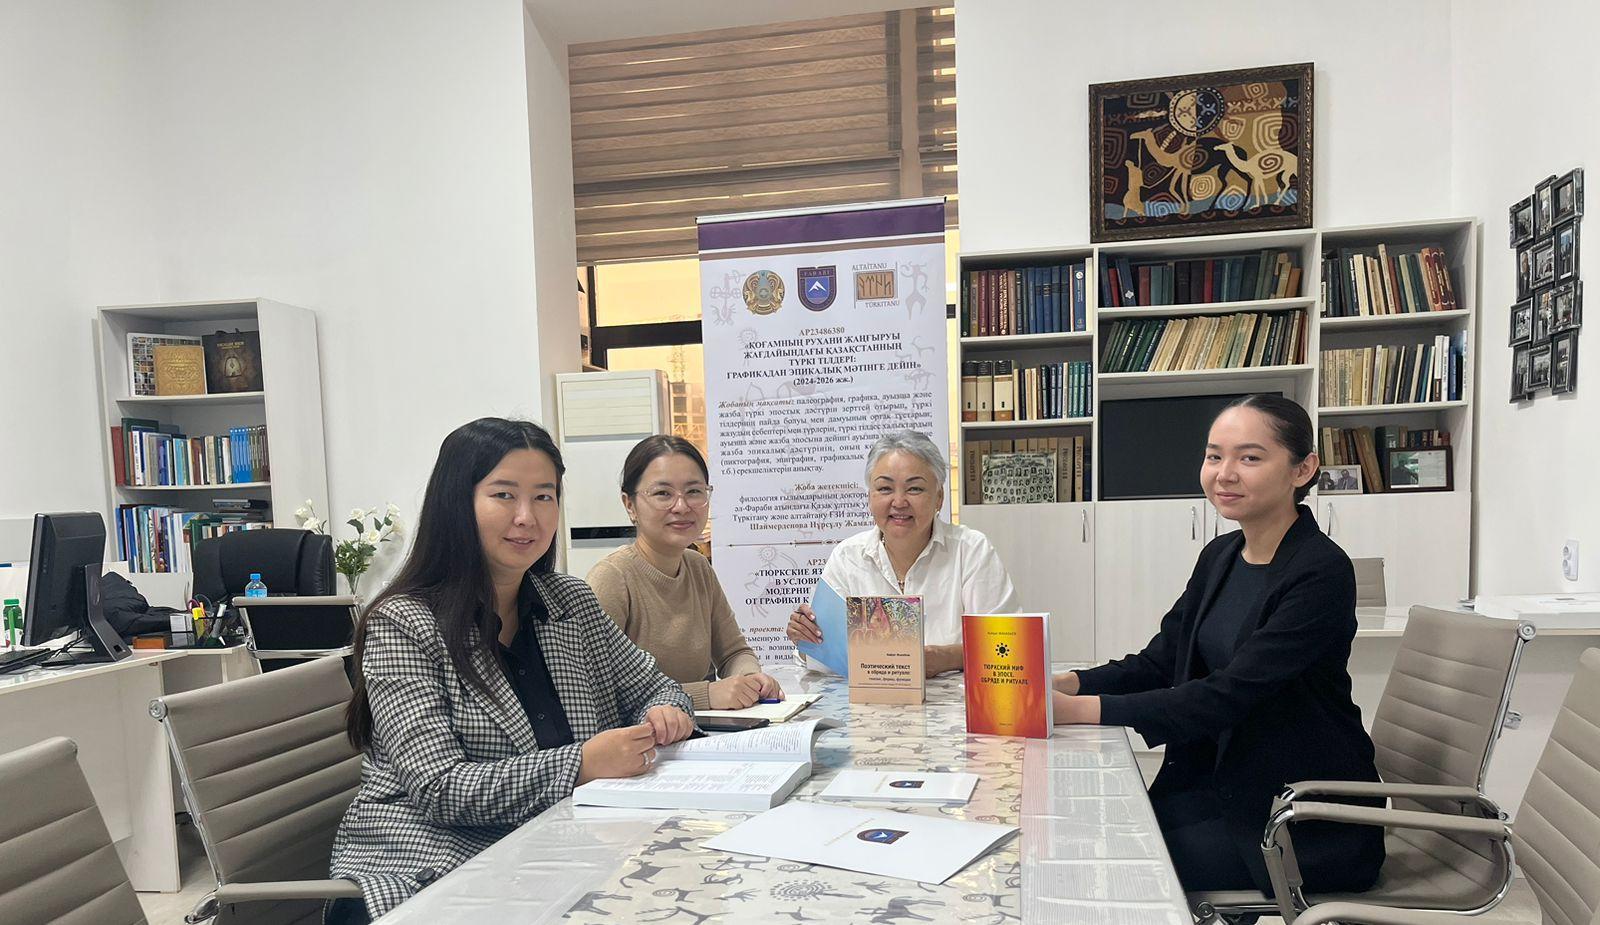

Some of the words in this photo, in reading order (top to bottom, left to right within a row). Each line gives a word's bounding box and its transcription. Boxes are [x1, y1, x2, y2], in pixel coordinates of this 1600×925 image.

[745, 339, 803, 350] «ҚОҒАМНЫҢ
[806, 337, 842, 346] РУХАНИ
[845, 333, 900, 344] ЖАҢҒЫРУЫ
[744, 348, 823, 359] ЖАҒДАЙЫНДАҒЫ
[826, 343, 902, 355] ҚАЗАҚСТАННЫҢ
[789, 358, 815, 366] ТҮРКІ
[819, 355, 856, 365] ТІЛДЕРІ:
[727, 369, 786, 379] ГРАФИКАДАН
[789, 367, 842, 376] ЭПИКАЛЫҚ
[844, 363, 885, 373] МӘТІНГЕ
[887, 361, 921, 371] ДЕЙІН»
[794, 377, 834, 387] (2024-2026
[794, 483, 815, 491] Жоба
[739, 495, 778, 504] филология
[755, 568, 809, 576] «ТЮРКСКИЕ
[783, 577, 820, 585] УСЛОВИ
[766, 587, 811, 595] МОДЕРНИ
[760, 596, 800, 604] ГРАФИКИ
[803, 596, 809, 604] К
